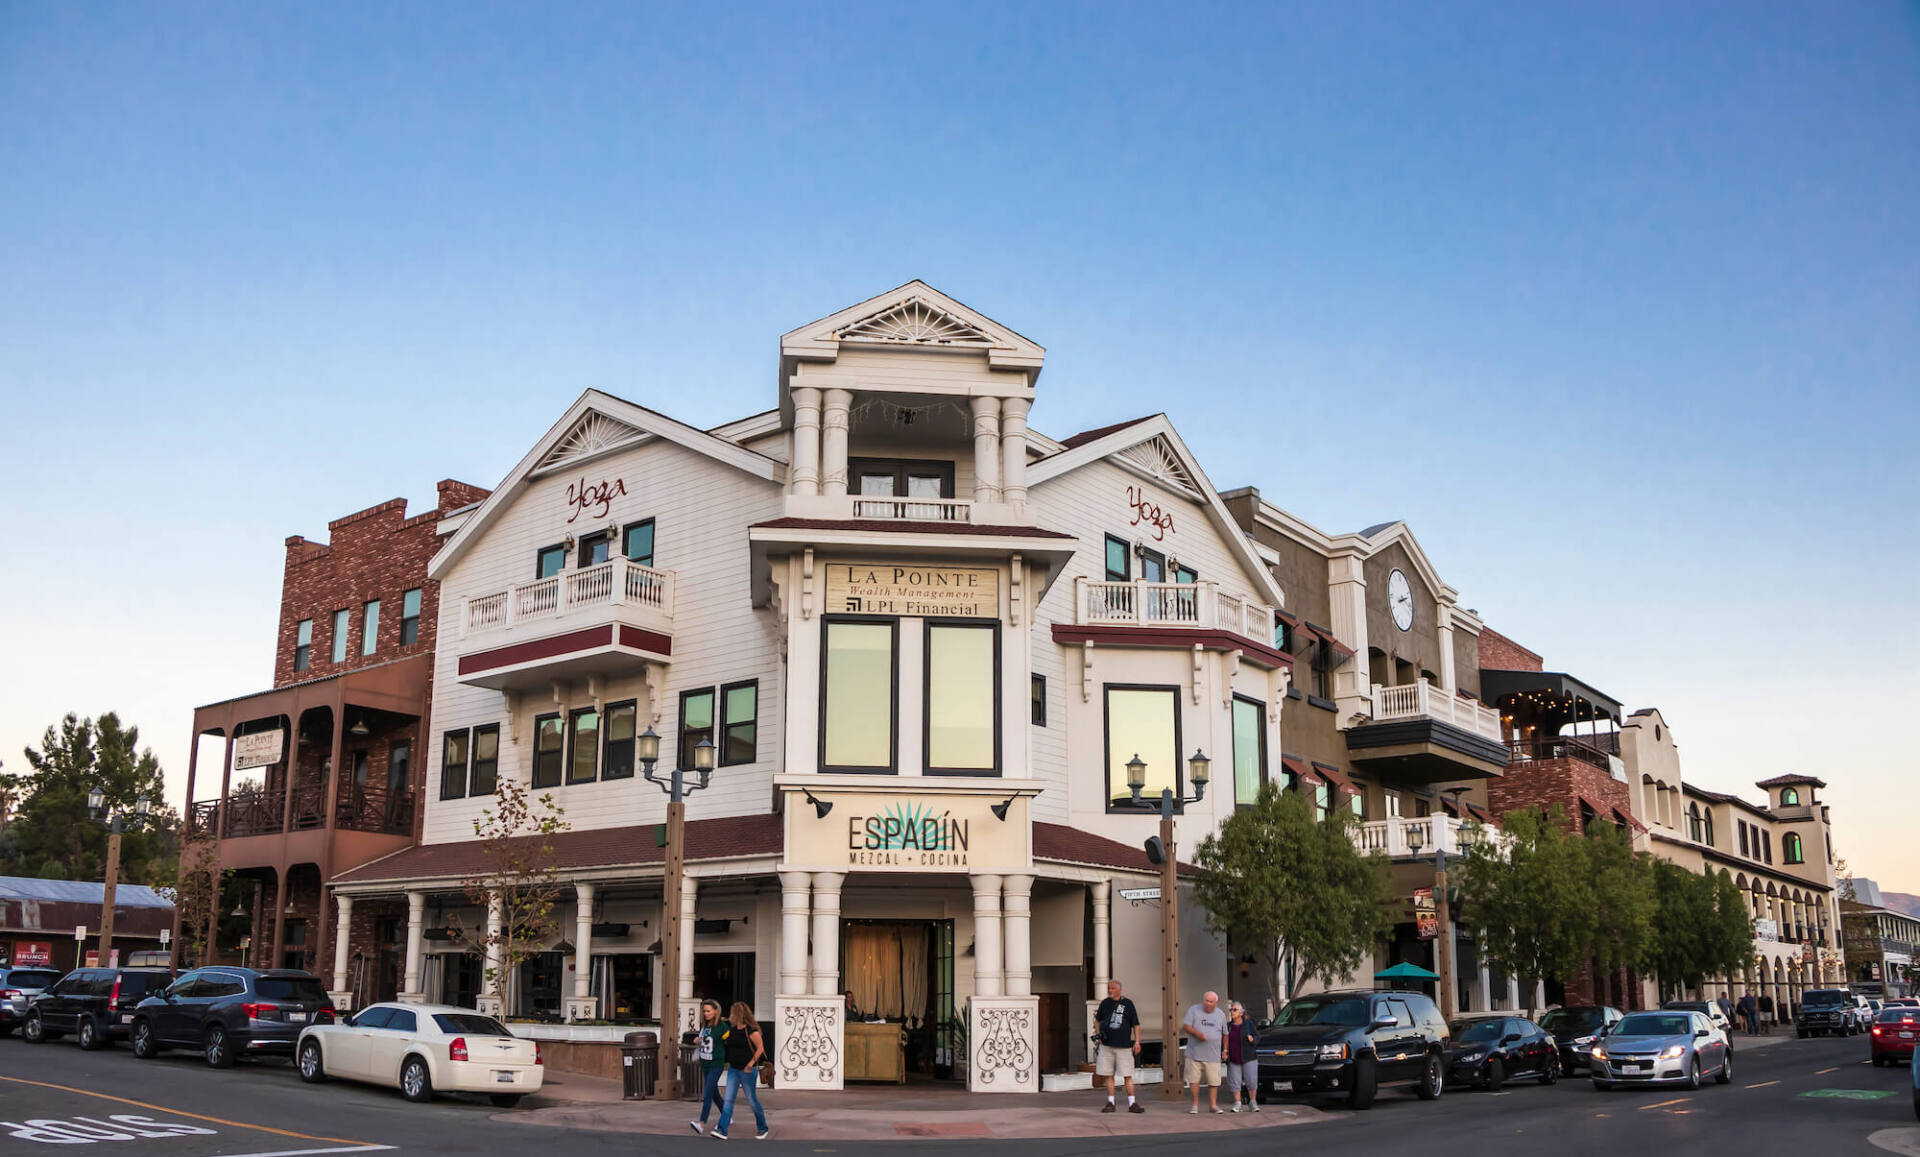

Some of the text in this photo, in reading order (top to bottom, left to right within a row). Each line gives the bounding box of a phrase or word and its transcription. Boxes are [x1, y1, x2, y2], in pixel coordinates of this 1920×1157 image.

[566, 477, 628, 523] Yoga
[1126, 486, 1176, 541] Yoga
[848, 567, 978, 587] LA POINTE
[850, 586, 975, 599] Wealth Management
[867, 600, 978, 615] LPL Financial
[849, 810, 968, 851] ESPADÍN
[849, 853, 967, 865] MEZCAL COCINA
[0, 1115, 218, 1144] STOP
